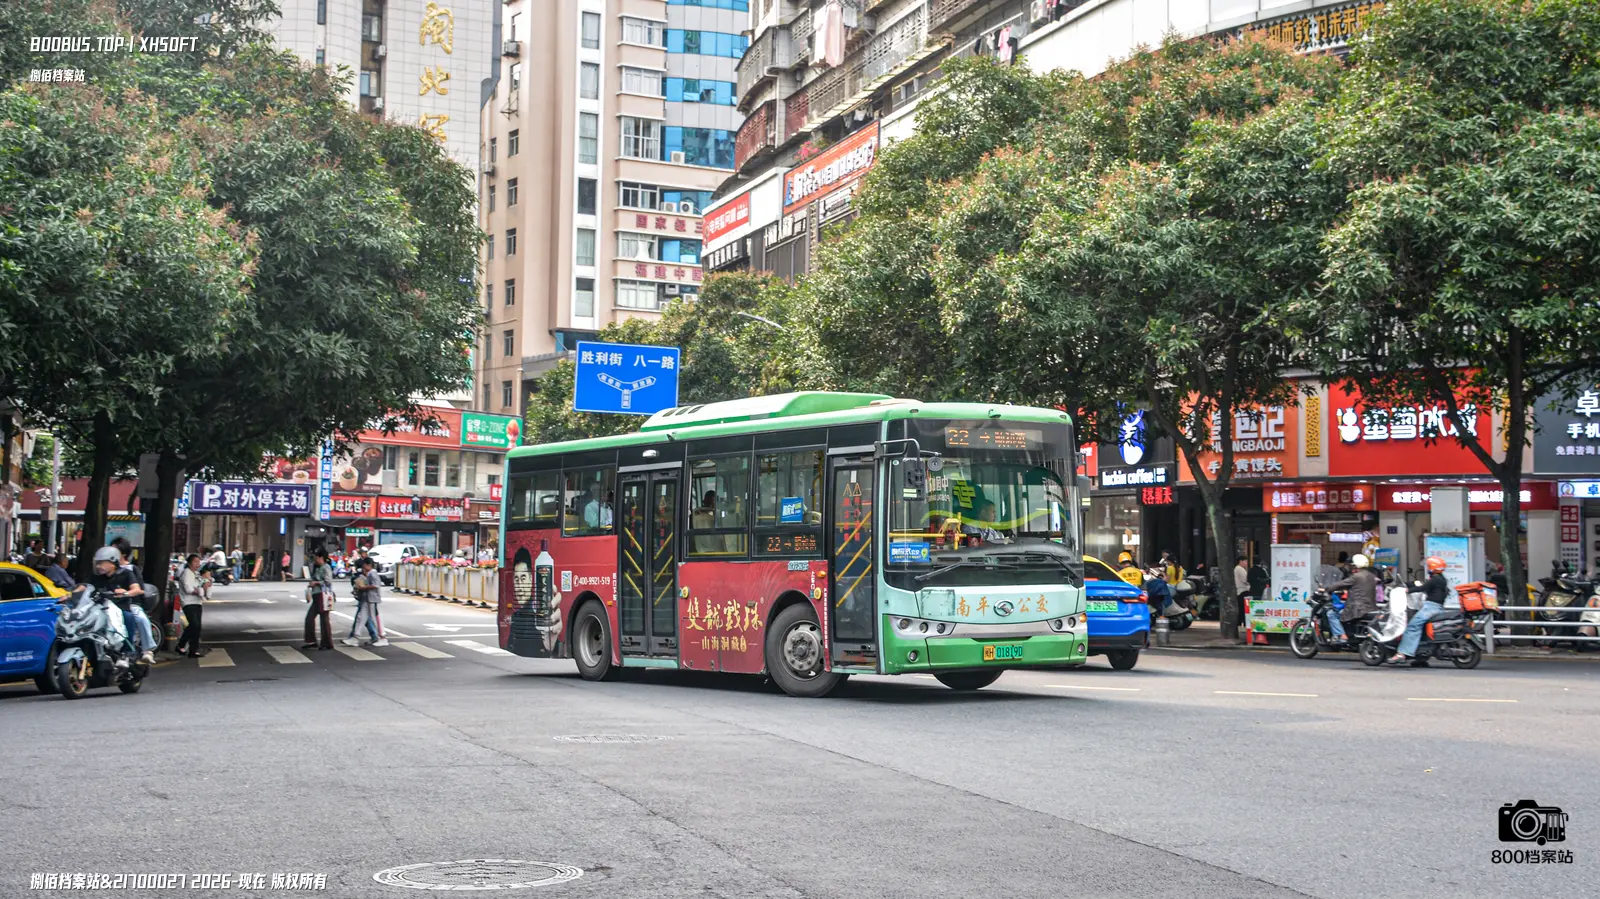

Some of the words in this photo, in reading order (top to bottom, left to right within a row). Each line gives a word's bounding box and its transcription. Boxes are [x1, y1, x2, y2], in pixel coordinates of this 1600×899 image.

[1314, 2, 1385, 41] 为未来而
[581, 351, 622, 366] 胜利街
[633, 355, 674, 369] 八一路
[948, 429, 969, 446] 22
[1211, 440, 1285, 453] HUNGBAOJI
[1556, 445, 1595, 455] 免费咨询
[1207, 457, 1282, 474] 手黄馒头
[1102, 469, 1126, 485] luckin
[1128, 468, 1153, 484] coffee
[224, 488, 307, 509] 对外停车场
[767, 537, 781, 552] 22
[957, 596, 989, 617] 南平
[1018, 594, 1048, 613] 公交
